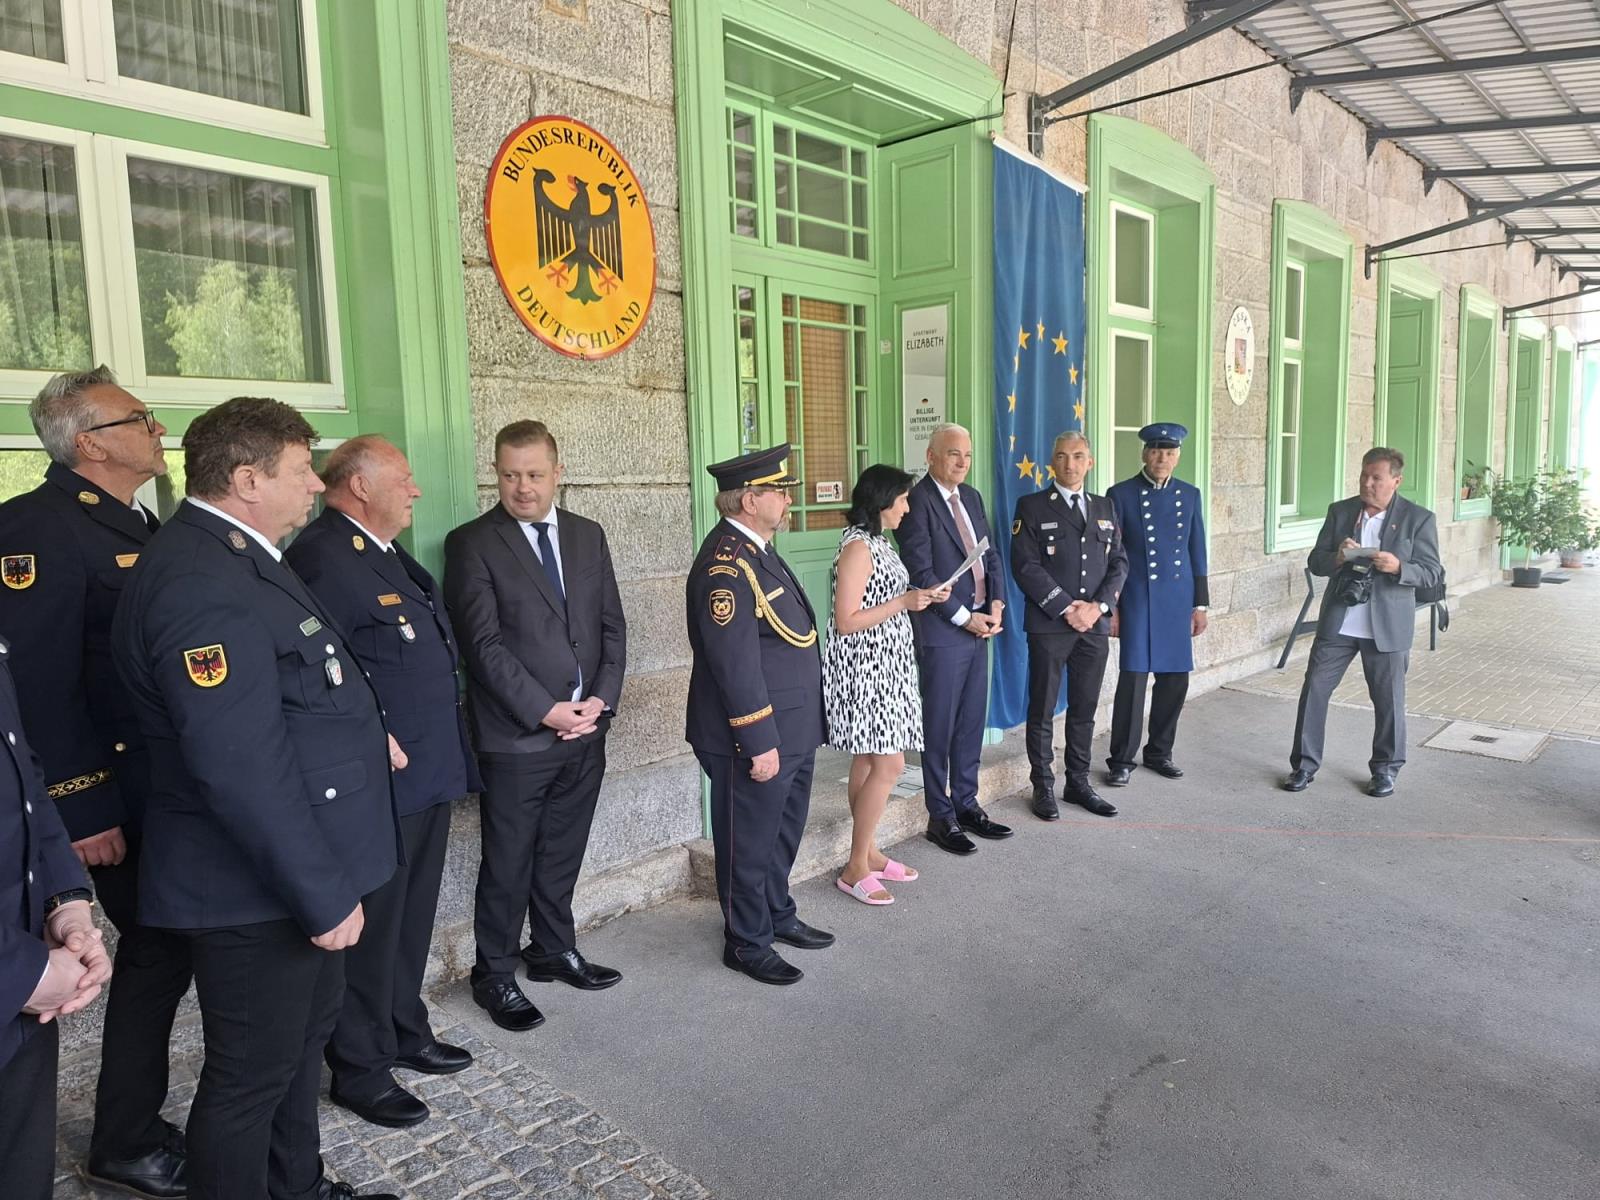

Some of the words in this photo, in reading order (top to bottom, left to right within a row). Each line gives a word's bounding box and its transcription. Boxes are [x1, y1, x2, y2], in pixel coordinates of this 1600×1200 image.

[502, 127, 640, 208] BUNDESREPUBLIK
[517, 284, 641, 349] DEUTSCHLAND
[906, 336, 944, 350] ELIZABETH
[915, 407, 935, 415] BILLIGE
[909, 415, 941, 424] UNTERKUNFT
